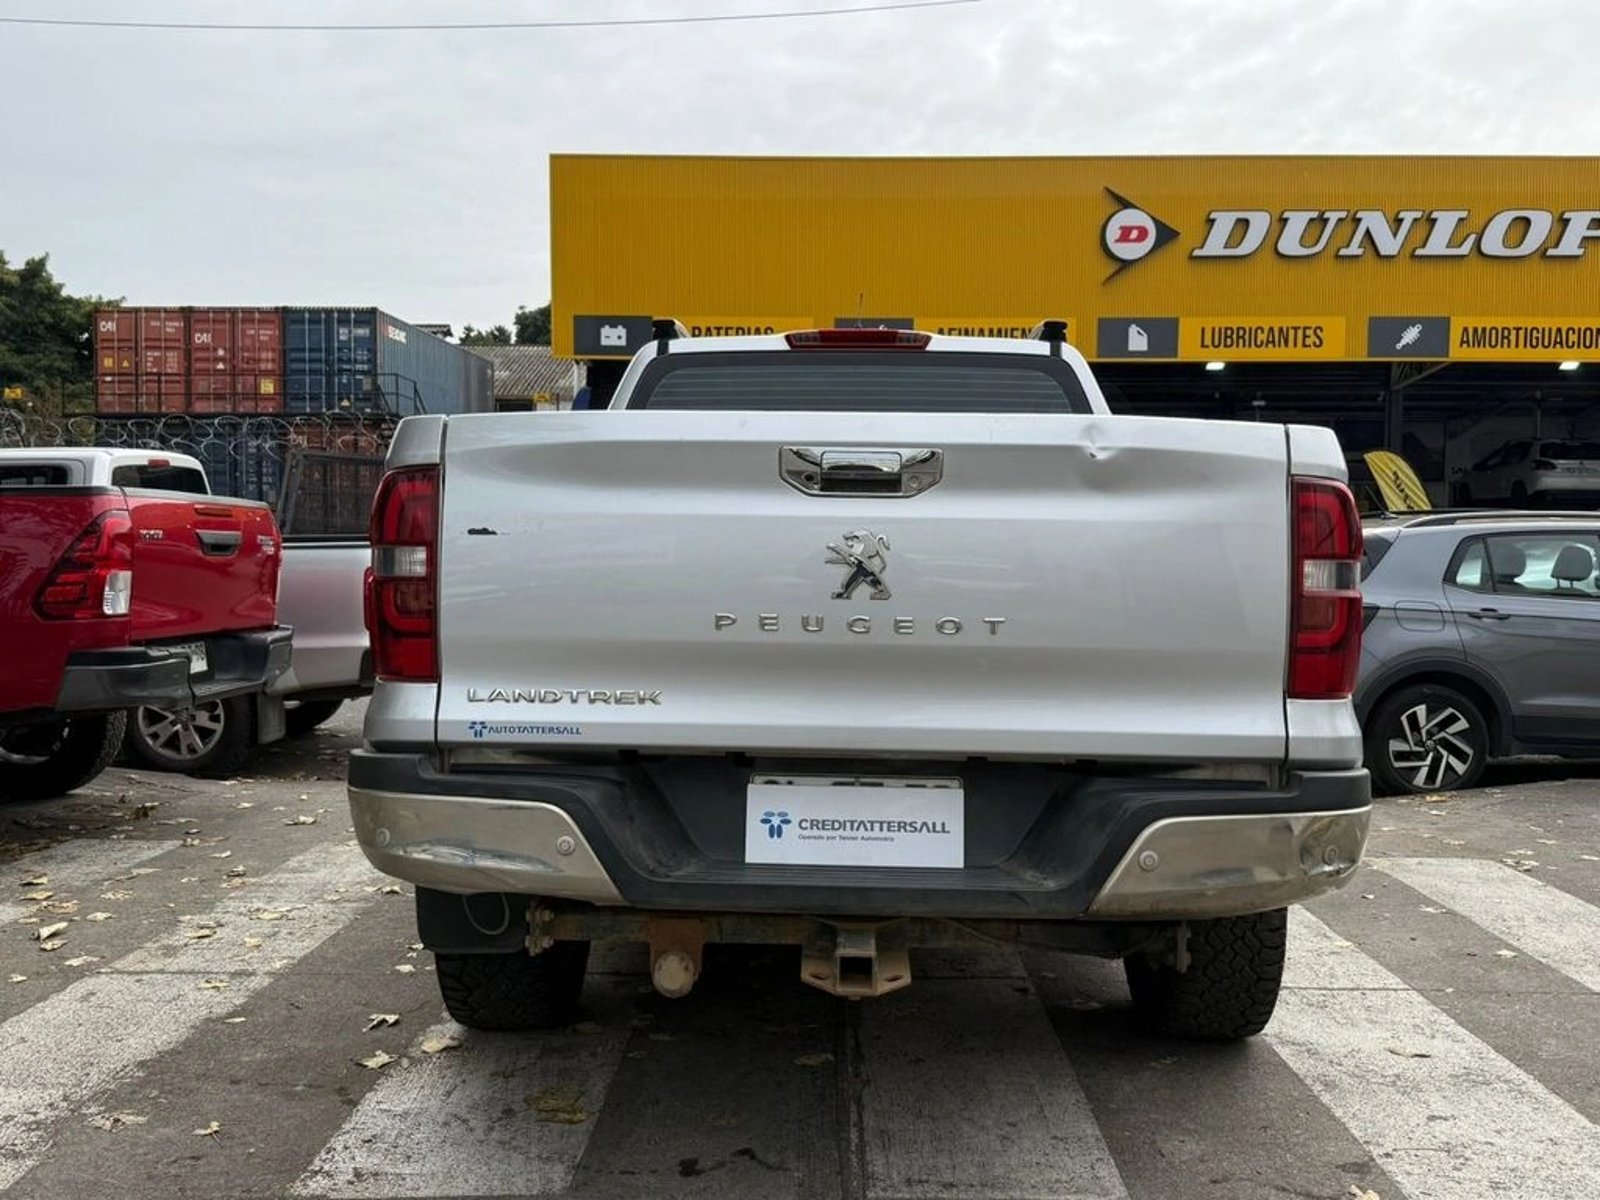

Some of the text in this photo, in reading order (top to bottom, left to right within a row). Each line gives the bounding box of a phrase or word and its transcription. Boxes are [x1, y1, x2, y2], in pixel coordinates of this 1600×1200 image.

[1114, 225, 1149, 244] D
[1190, 209, 1600, 257] DUNLOP
[1200, 325, 1324, 349] LUBRICANTES
[714, 612, 1006, 635] PEUGEOT
[466, 687, 663, 706] LANDTREK
[488, 725, 583, 736] AUTOTATTERSALL
[798, 818, 950, 834] CREDITATTERSALL
